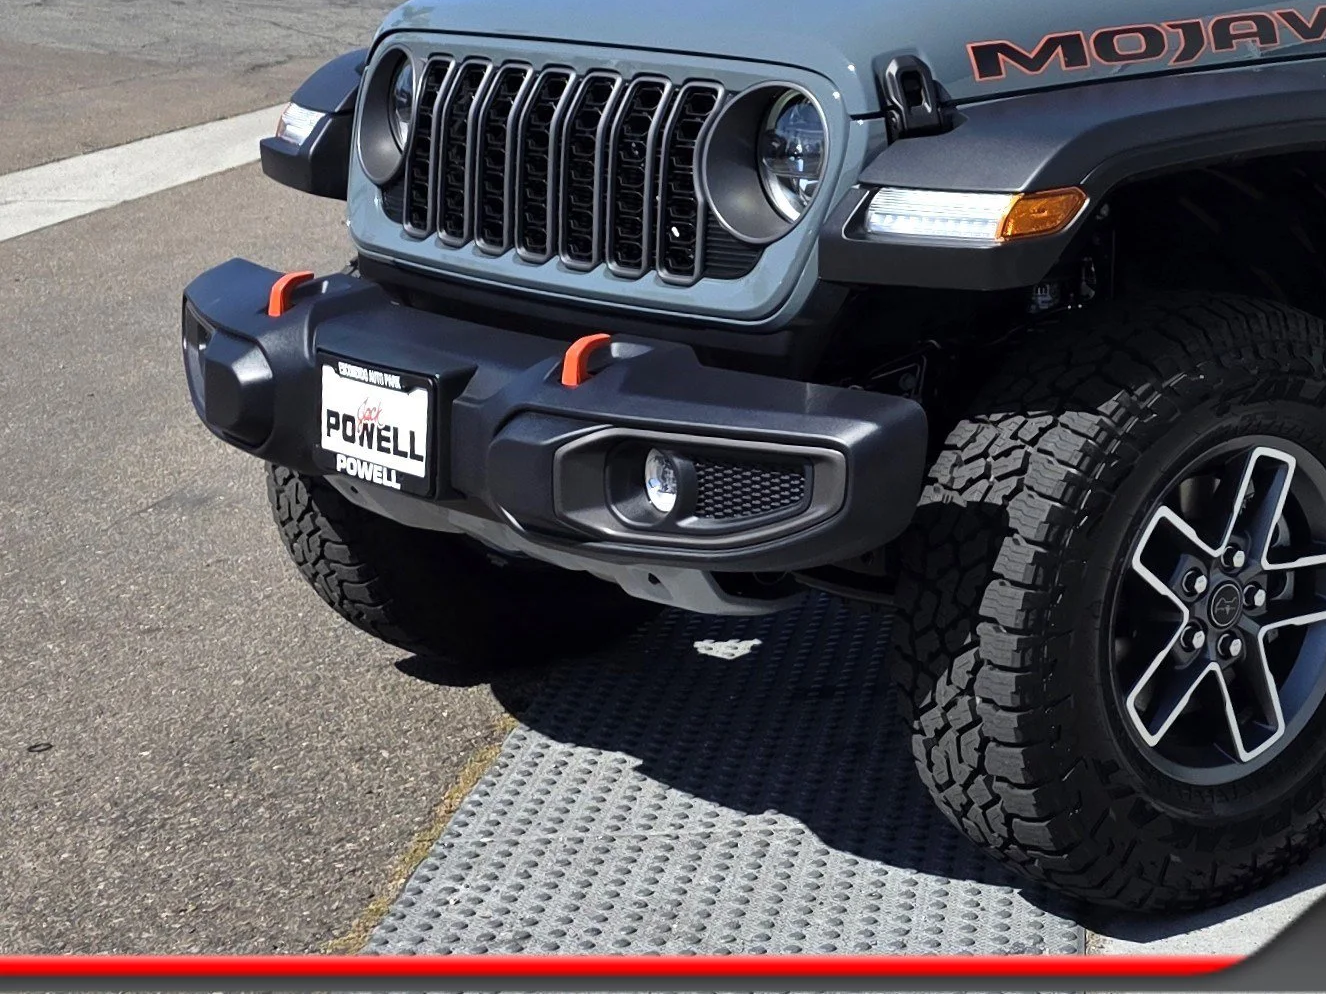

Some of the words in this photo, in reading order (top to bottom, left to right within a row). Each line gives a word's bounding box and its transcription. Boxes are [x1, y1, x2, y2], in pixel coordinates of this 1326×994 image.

[357, 397, 383, 433] Jack
[327, 409, 424, 462] POWELL
[336, 454, 401, 490] POWELL
